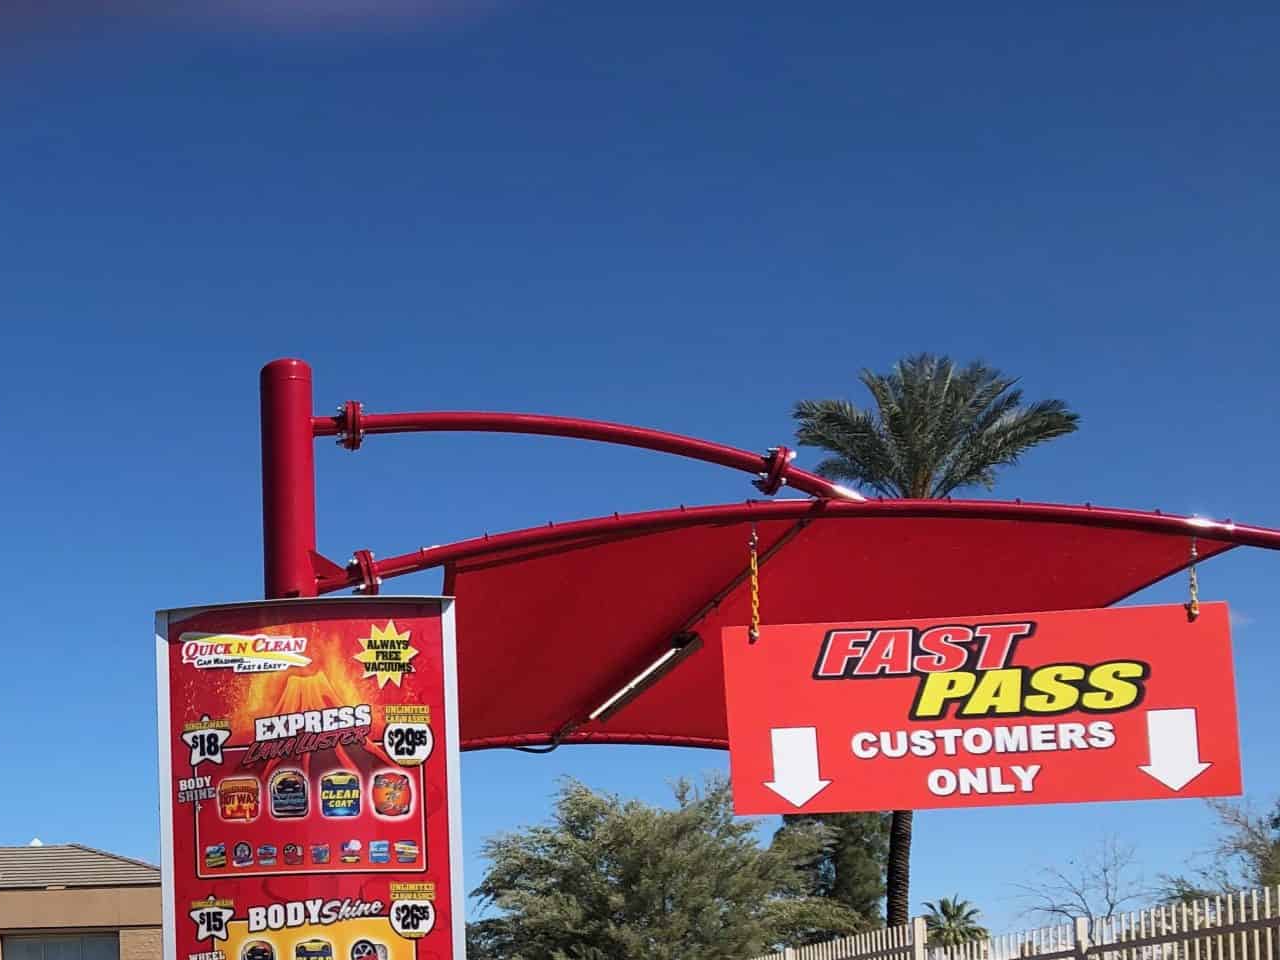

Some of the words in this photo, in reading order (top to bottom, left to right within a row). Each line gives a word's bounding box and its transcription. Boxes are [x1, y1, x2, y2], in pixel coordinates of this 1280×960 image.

[185, 642, 232, 660] QUICK
[252, 638, 304, 653] CLEAN
[367, 640, 408, 650] ALWAYS
[819, 622, 1031, 677] FAST
[375, 651, 401, 661] FREE
[364, 662, 412, 673] VACUUMS
[915, 661, 1145, 717] PASS
[255, 704, 371, 741] EXPRESS
[191, 732, 219, 757] $18
[851, 721, 1116, 759] CUSTOMERS
[178, 775, 211, 791] BODY
[927, 765, 1041, 796] ONLY
[178, 787, 216, 803] SHINE
[322, 789, 360, 799] CLEAR
[329, 799, 353, 808] COAT
[199, 911, 222, 932] $15
[248, 900, 322, 931] BODY
[320, 898, 383, 924] Shine
